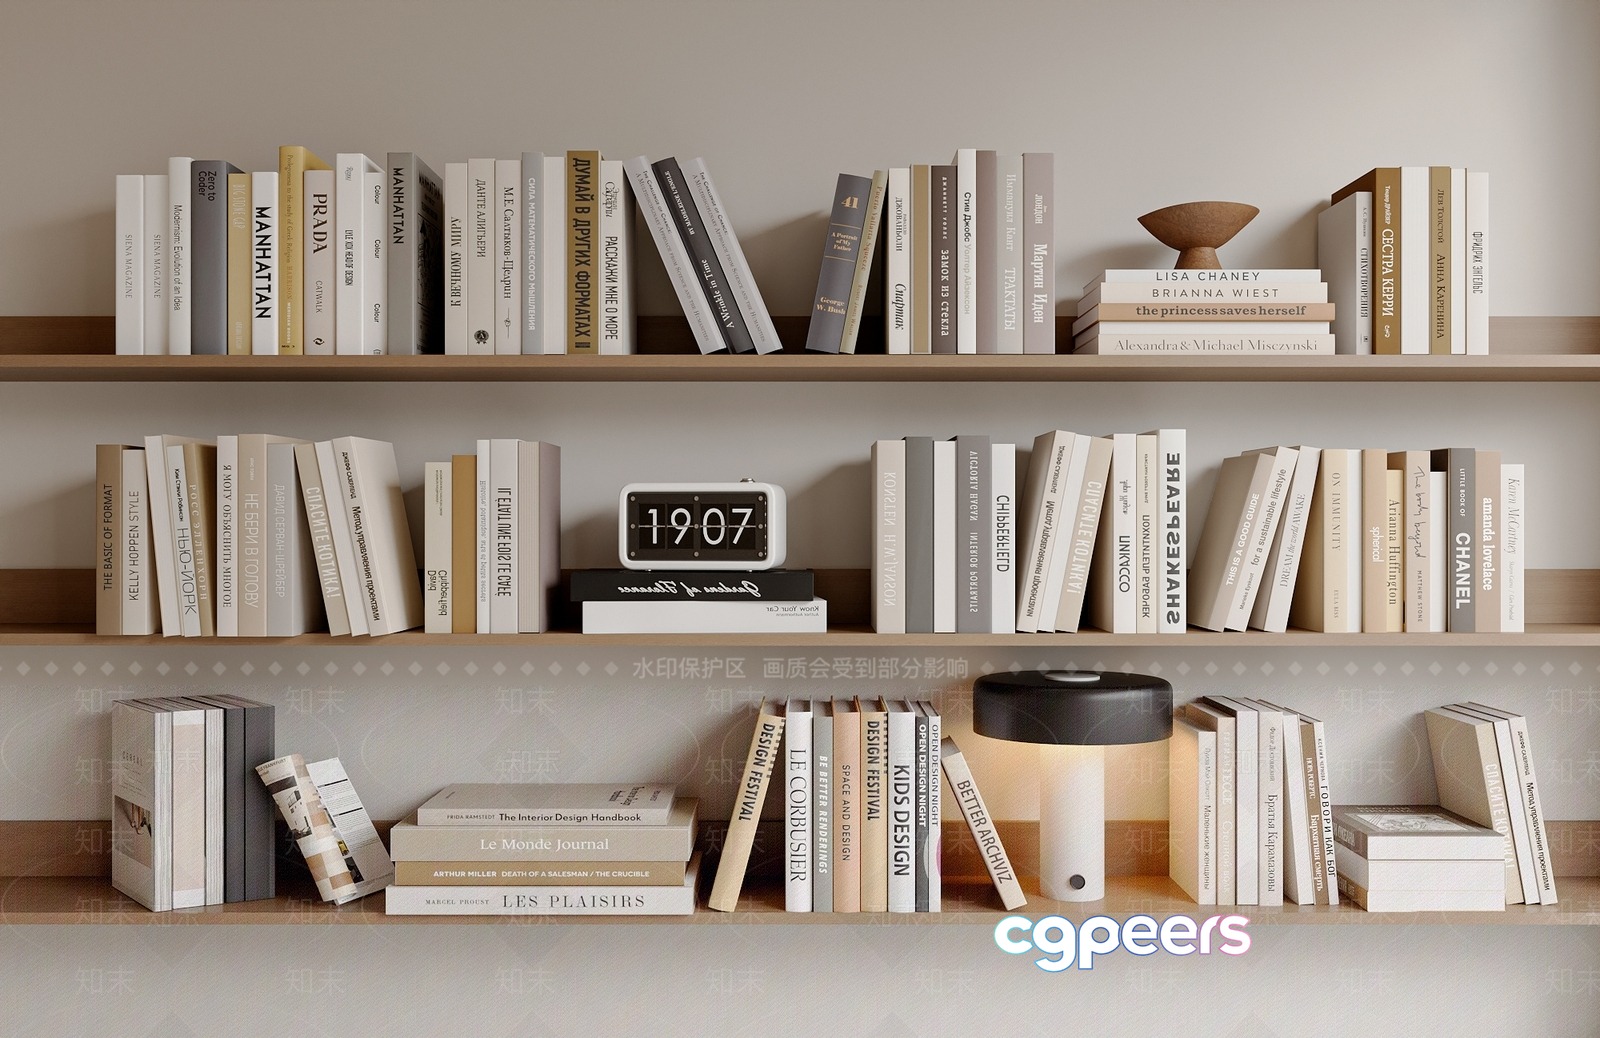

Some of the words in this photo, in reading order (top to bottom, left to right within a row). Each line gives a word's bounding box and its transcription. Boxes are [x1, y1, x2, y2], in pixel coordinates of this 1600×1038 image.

[198, 170, 208, 196] Coder
[208, 170, 218, 190] Zero
[208, 192, 217, 202] to
[374, 184, 382, 205] Colour
[475, 178, 486, 210] ДАНТЕ
[528, 177, 536, 200] СИЛА
[572, 158, 594, 202] ДУМАЙ
[392, 167, 404, 244] MANHATTAN
[574, 206, 590, 214] В
[841, 195, 859, 210] 41
[964, 192, 972, 212] Стив
[312, 192, 328, 254] PRADA
[476, 210, 486, 258] АЛИГЬЕРИ
[894, 196, 903, 252] ДЖОВАНЬОЛИ
[962, 214, 972, 242] Джобс
[374, 238, 382, 260] Colour
[528, 202, 536, 281] МАТЕМАТИЧЕСКОГО
[572, 217, 590, 268] ДРУГИХ
[963, 243, 971, 274] Уолтер
[1381, 228, 1394, 276] СЕСТРА
[1471, 231, 1484, 263] ФРИДРИХ
[255, 206, 272, 319] MANHATTAN
[604, 236, 618, 284] РАССКАЖИ
[701, 260, 714, 281] Time
[1030, 243, 1048, 289] Мартин
[1156, 272, 1190, 281] LISA
[1197, 271, 1261, 282] CHANEY
[315, 280, 324, 314] CATWALK
[604, 286, 618, 305] МНЕ
[710, 280, 718, 290] in
[964, 274, 972, 315] Айзексон
[1152, 288, 1224, 298] BRIANNA
[1232, 288, 1280, 298] WIEST
[1360, 247, 1369, 318] СТИХОТВОРЕНИЯ
[1472, 265, 1484, 295] ЭНГЕЛЬС
[374, 302, 382, 323] Colour
[528, 282, 536, 330] МЫШЛЕНИЯ
[574, 270, 590, 338] ФОРМАТАХ
[712, 290, 730, 322] Wrinkle
[820, 296, 845, 306] George
[892, 282, 907, 331] Спартак
[1032, 293, 1048, 324] Иден
[1136, 306, 1158, 316] the
[1160, 306, 1218, 318] princess
[1219, 307, 1257, 316] saves
[1258, 305, 1307, 316] herself
[1381, 278, 1394, 317] КЕРРИ
[604, 316, 618, 340] МОРЕ
[726, 321, 734, 329] A
[223, 474, 232, 501] МОГУ
[1413, 466, 1426, 490] The
[1508, 478, 1520, 504] Karen
[103, 483, 113, 524] FORMAT
[128, 490, 139, 522] STYLE
[244, 493, 258, 510] НЕ
[305, 486, 331, 542] СПАСИТЕ
[1459, 508, 1466, 517] OF
[103, 526, 113, 540] OF
[223, 504, 232, 564] ОБЪЯСНИТЬ
[244, 512, 258, 544] БЕРИ
[648, 507, 754, 545] 1907
[1388, 499, 1400, 542] Arianna
[1482, 497, 1495, 542] amanda
[1503, 506, 1520, 554] McCartney
[103, 544, 113, 569] BASIC
[128, 526, 139, 567] HOPPEN
[244, 548, 258, 556] В
[1370, 526, 1384, 562] spherical
[103, 572, 113, 591] THE
[176, 528, 197, 615] НЬЮ-ЙОРК
[244, 558, 258, 609] ГОЛОВУ
[317, 544, 341, 598] КОТИКА!
[1386, 546, 1400, 606] Huffington
[1455, 532, 1471, 610] CHANEL
[1482, 544, 1496, 592] lovelace
[128, 571, 139, 601] KELLY
[223, 566, 232, 608] МНОГОЕ
[753, 722, 776, 768] DESIGN
[866, 720, 880, 765] DESIGN
[918, 724, 926, 752] OPEN
[931, 724, 939, 752] OPEN
[789, 749, 807, 771] LE
[819, 755, 828, 768] BE
[918, 754, 926, 793] DESIGN
[931, 754, 939, 793] DESIGN
[738, 770, 763, 821] FESTIVAL
[819, 770, 828, 808] BETTER
[841, 764, 851, 796] SPACE
[866, 769, 880, 821] FESTIVAL
[894, 764, 910, 806] KIDS
[499, 813, 516, 822] The
[518, 813, 553, 822] Interior
[555, 812, 588, 824] Design
[591, 812, 642, 822] Handbook
[841, 799, 851, 821] AND
[918, 794, 926, 828] NIGHT
[931, 794, 939, 828] NIGHT
[1264, 794, 1278, 829] Братья
[1320, 784, 1332, 834] ГОВОРИ
[480, 838, 497, 850] Le
[501, 838, 552, 850] Monde
[553, 838, 610, 850] Journal
[789, 775, 808, 883] CORBUSIER
[819, 810, 828, 874] RENDERINGS
[841, 824, 851, 862] DESIGN
[894, 810, 910, 877] DESIGN
[956, 779, 988, 828] BETTER
[977, 828, 1013, 884] ARCHVIZ
[1202, 805, 1212, 850] Маленькие
[1266, 832, 1278, 892] Карамазовы
[1325, 837, 1334, 856] КАК
[433, 870, 466, 878] ARTHUR
[468, 870, 497, 878] MILLER
[501, 870, 527, 878] DEATH
[528, 870, 540, 878] OF
[540, 870, 547, 878] A
[547, 870, 589, 878] SALESMAN
[589, 870, 595, 878] /
[595, 870, 611, 878] THE
[612, 870, 650, 878] CRUCIBLE
[1202, 850, 1211, 890] женщины
[1326, 860, 1336, 878] БОГ
[502, 895, 539, 908] LES
[550, 895, 645, 908] PLAISIRS
